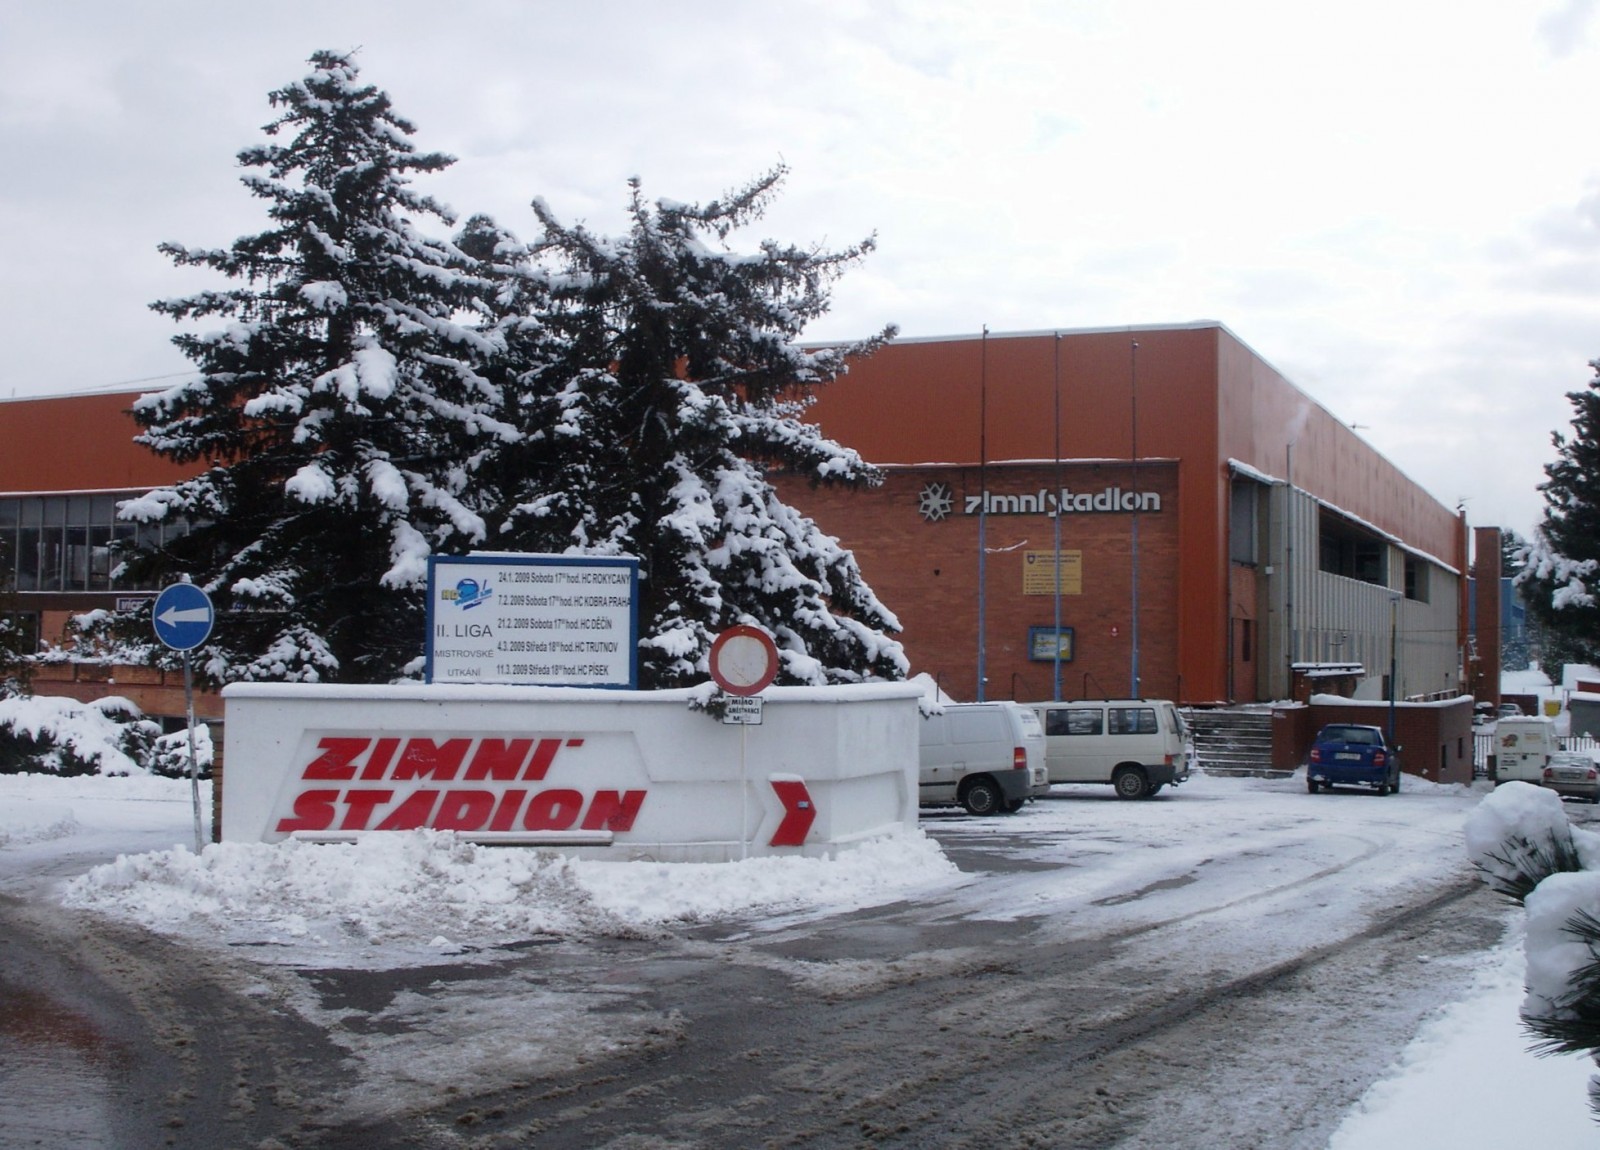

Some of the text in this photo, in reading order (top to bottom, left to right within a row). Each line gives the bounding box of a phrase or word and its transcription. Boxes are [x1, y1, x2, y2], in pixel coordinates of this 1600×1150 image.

[531, 572, 554, 583] Sobota
[582, 573, 591, 584] HC
[592, 573, 631, 584] ROKYCANY
[526, 595, 548, 606] Sobota
[574, 596, 583, 607] HC
[584, 596, 607, 607] KOBRA
[608, 596, 630, 608] PRAHA
[530, 618, 552, 629] Sobota
[580, 619, 590, 630] HC
[436, 624, 492, 638] II. LIGA
[575, 642, 584, 652] HC
[586, 642, 618, 652] TRUTNOV
[434, 650, 494, 658] MISTROVSKÉ
[578, 665, 588, 676] HC
[588, 662, 609, 676] PÍSEK
[302, 737, 584, 781] ZIMNÍ
[276, 789, 648, 832] STADION
